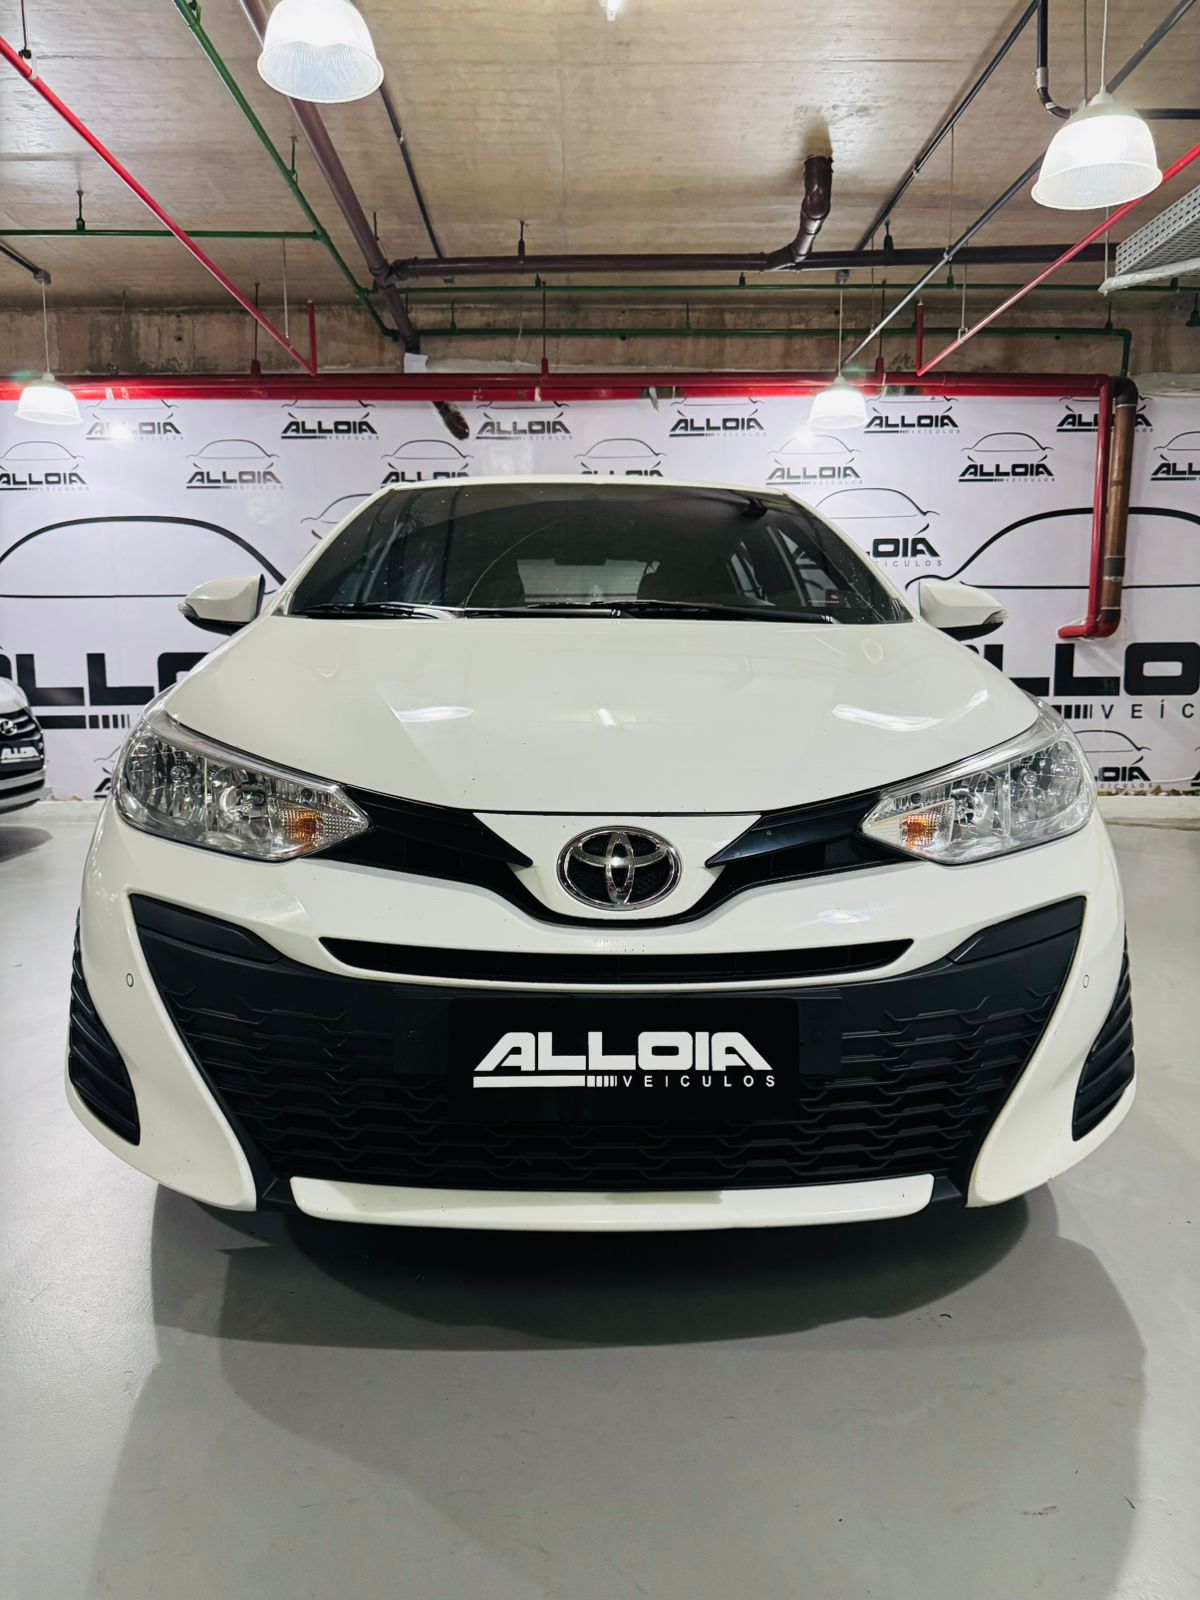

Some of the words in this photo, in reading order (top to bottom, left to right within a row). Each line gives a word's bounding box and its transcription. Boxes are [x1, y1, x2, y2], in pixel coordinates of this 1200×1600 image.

[281, 421, 378, 434] ALLOIA
[477, 421, 571, 434] ALLOIA
[670, 418, 765, 432] ALLOIA
[864, 415, 959, 428] ALLOIA
[766, 467, 861, 480] ALLOIA
[959, 464, 1055, 477] ALLOIA
[186, 471, 282, 484] ALLOIA
[473, 1031, 774, 1072] ALLOIA
[622, 1075, 776, 1088] VEICULOS
